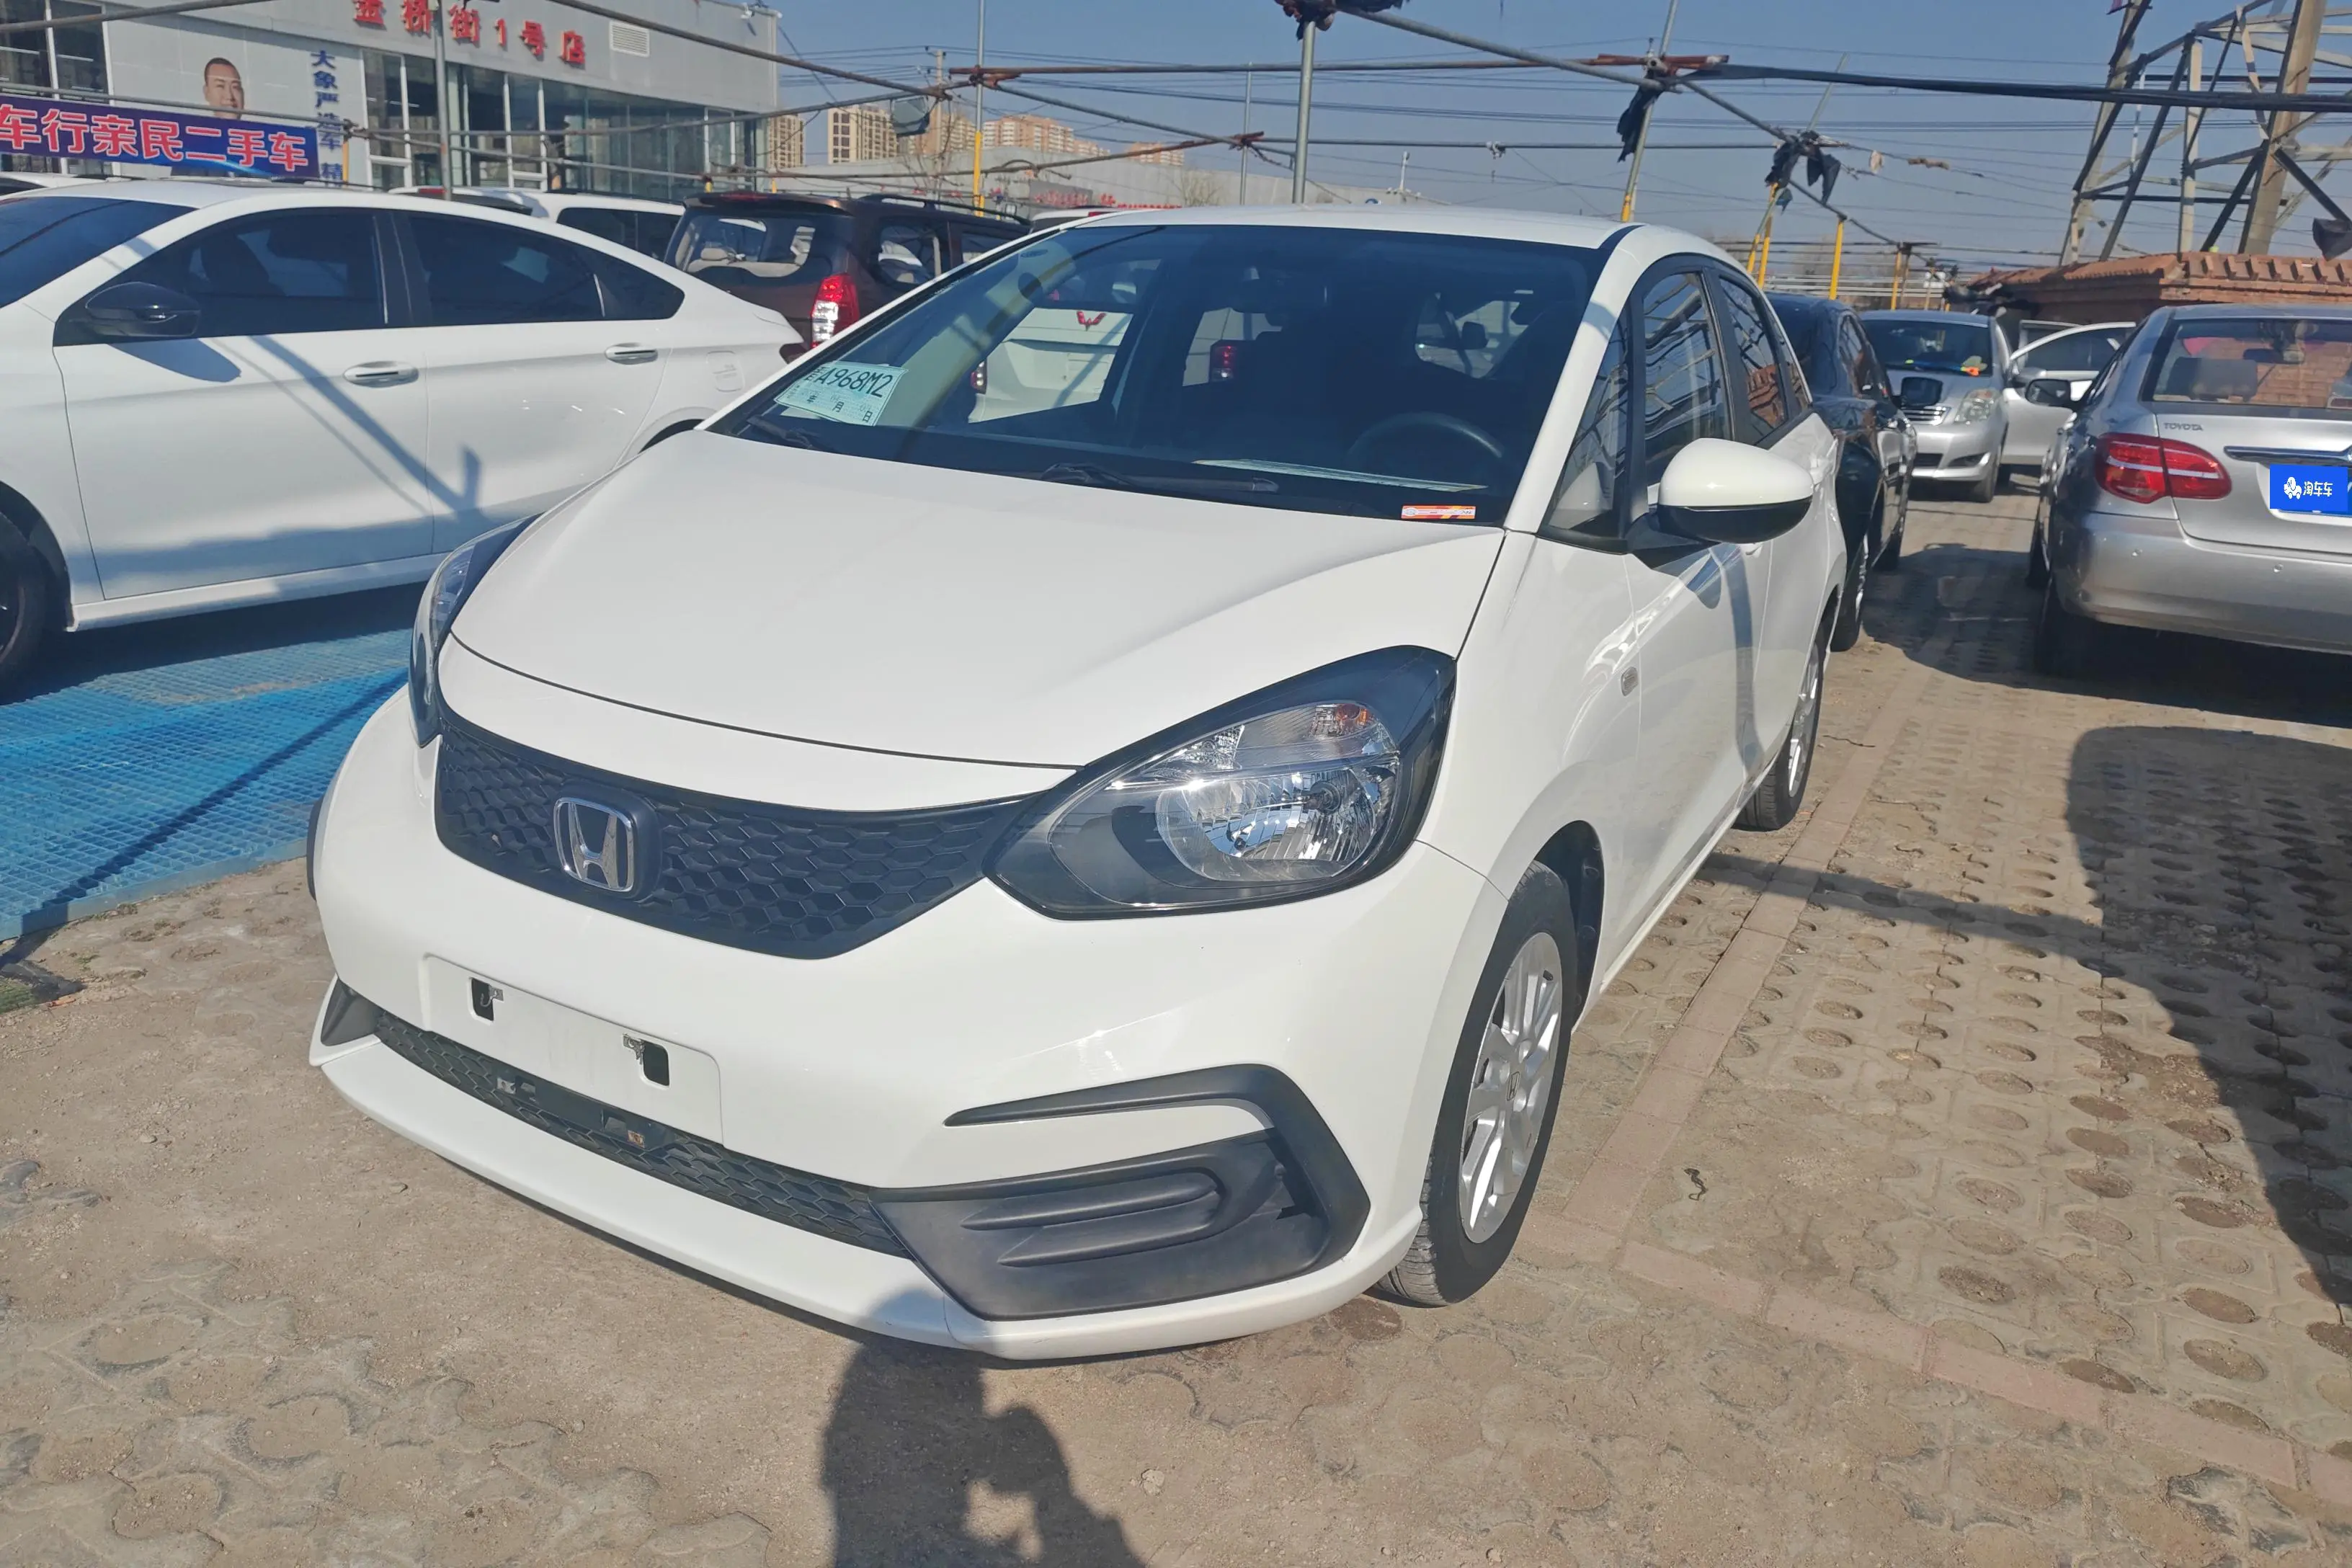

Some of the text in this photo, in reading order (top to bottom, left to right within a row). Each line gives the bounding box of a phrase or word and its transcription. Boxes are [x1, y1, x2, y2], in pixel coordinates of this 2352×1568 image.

[0, 104, 308, 172] 车行亲民二手车
[2163, 422, 2204, 431] TOYOTA
